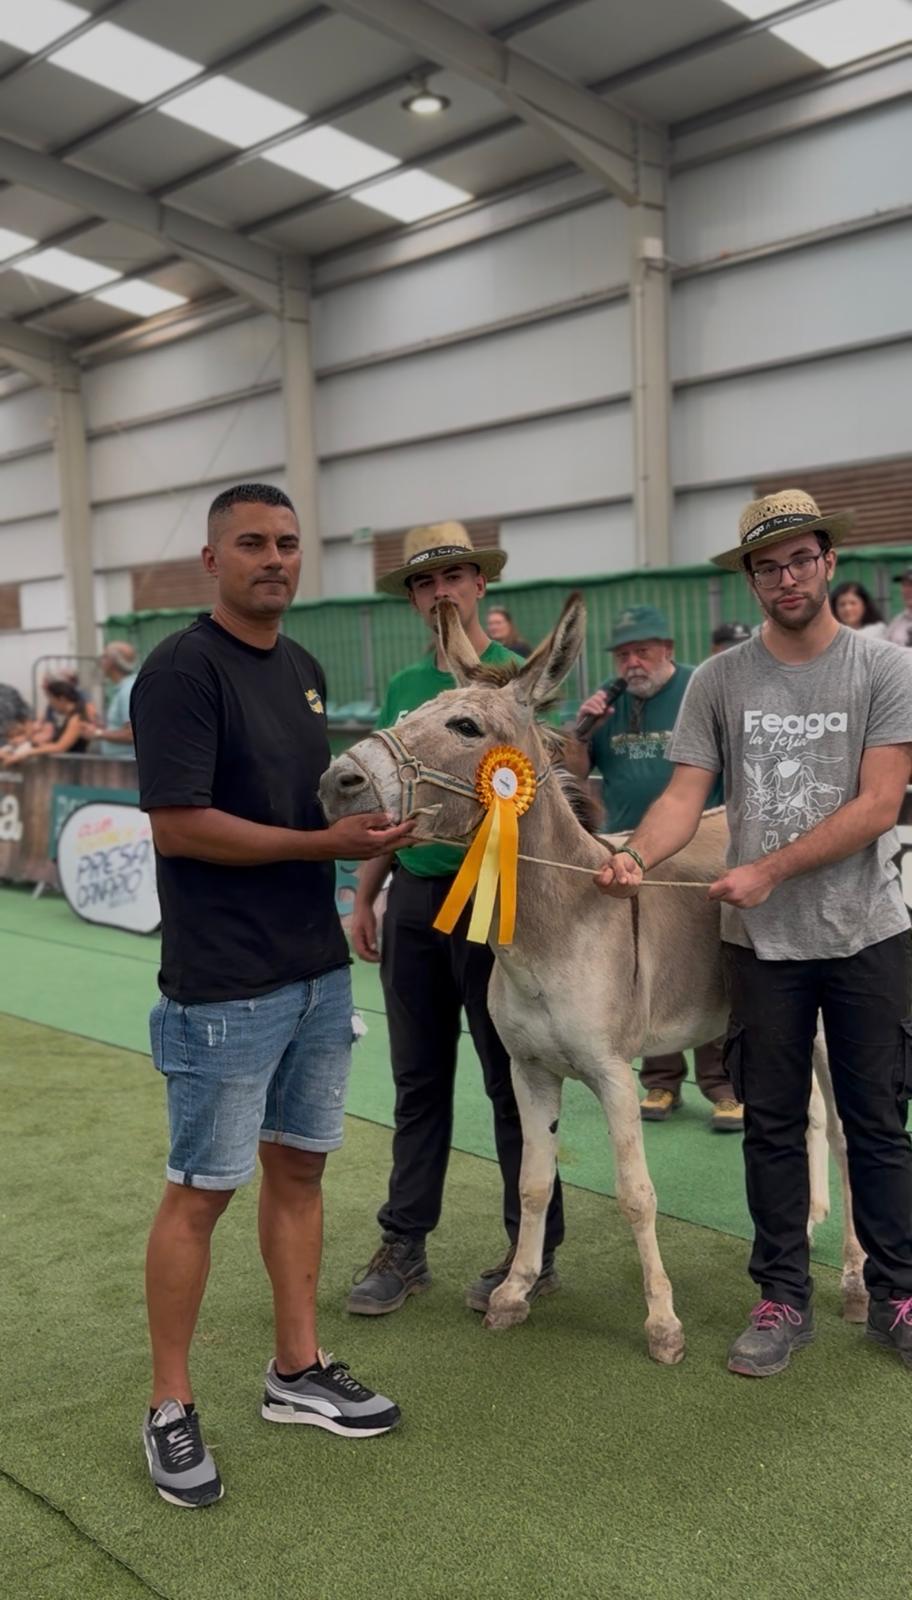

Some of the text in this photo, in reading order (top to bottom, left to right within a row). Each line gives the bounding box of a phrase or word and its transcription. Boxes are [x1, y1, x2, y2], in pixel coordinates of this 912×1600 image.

[744, 710, 848, 739] Feaga
[749, 727, 809, 752] la feria
